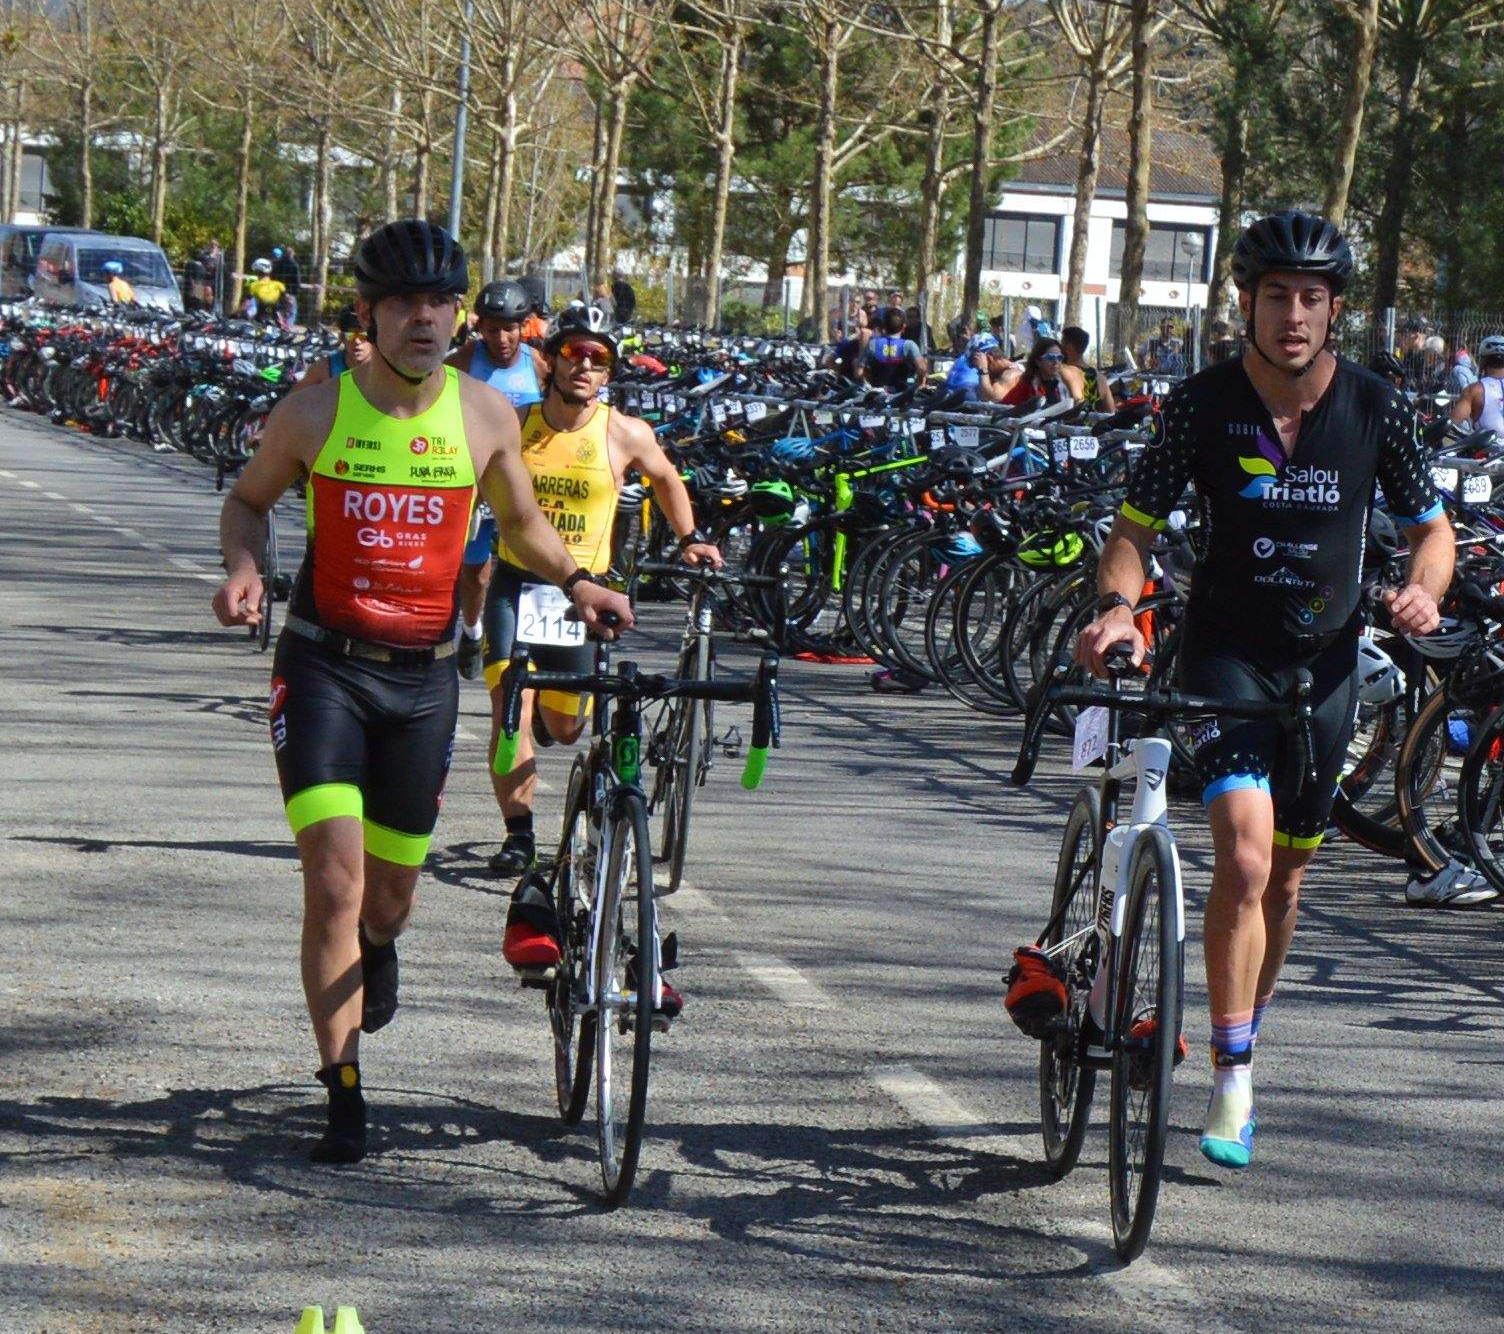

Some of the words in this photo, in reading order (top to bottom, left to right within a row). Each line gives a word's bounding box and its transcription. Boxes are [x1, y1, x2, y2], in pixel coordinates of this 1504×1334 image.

[1073, 438, 1096, 451] 2656
[1284, 464, 1340, 485] Salou
[533, 474, 589, 500] ARRERAS
[1260, 482, 1341, 504] Triatló
[344, 489, 444, 525] ROYES
[1262, 501, 1293, 509] COSTA
[522, 612, 582, 641] 2114
[273, 714, 287, 751] TRI
